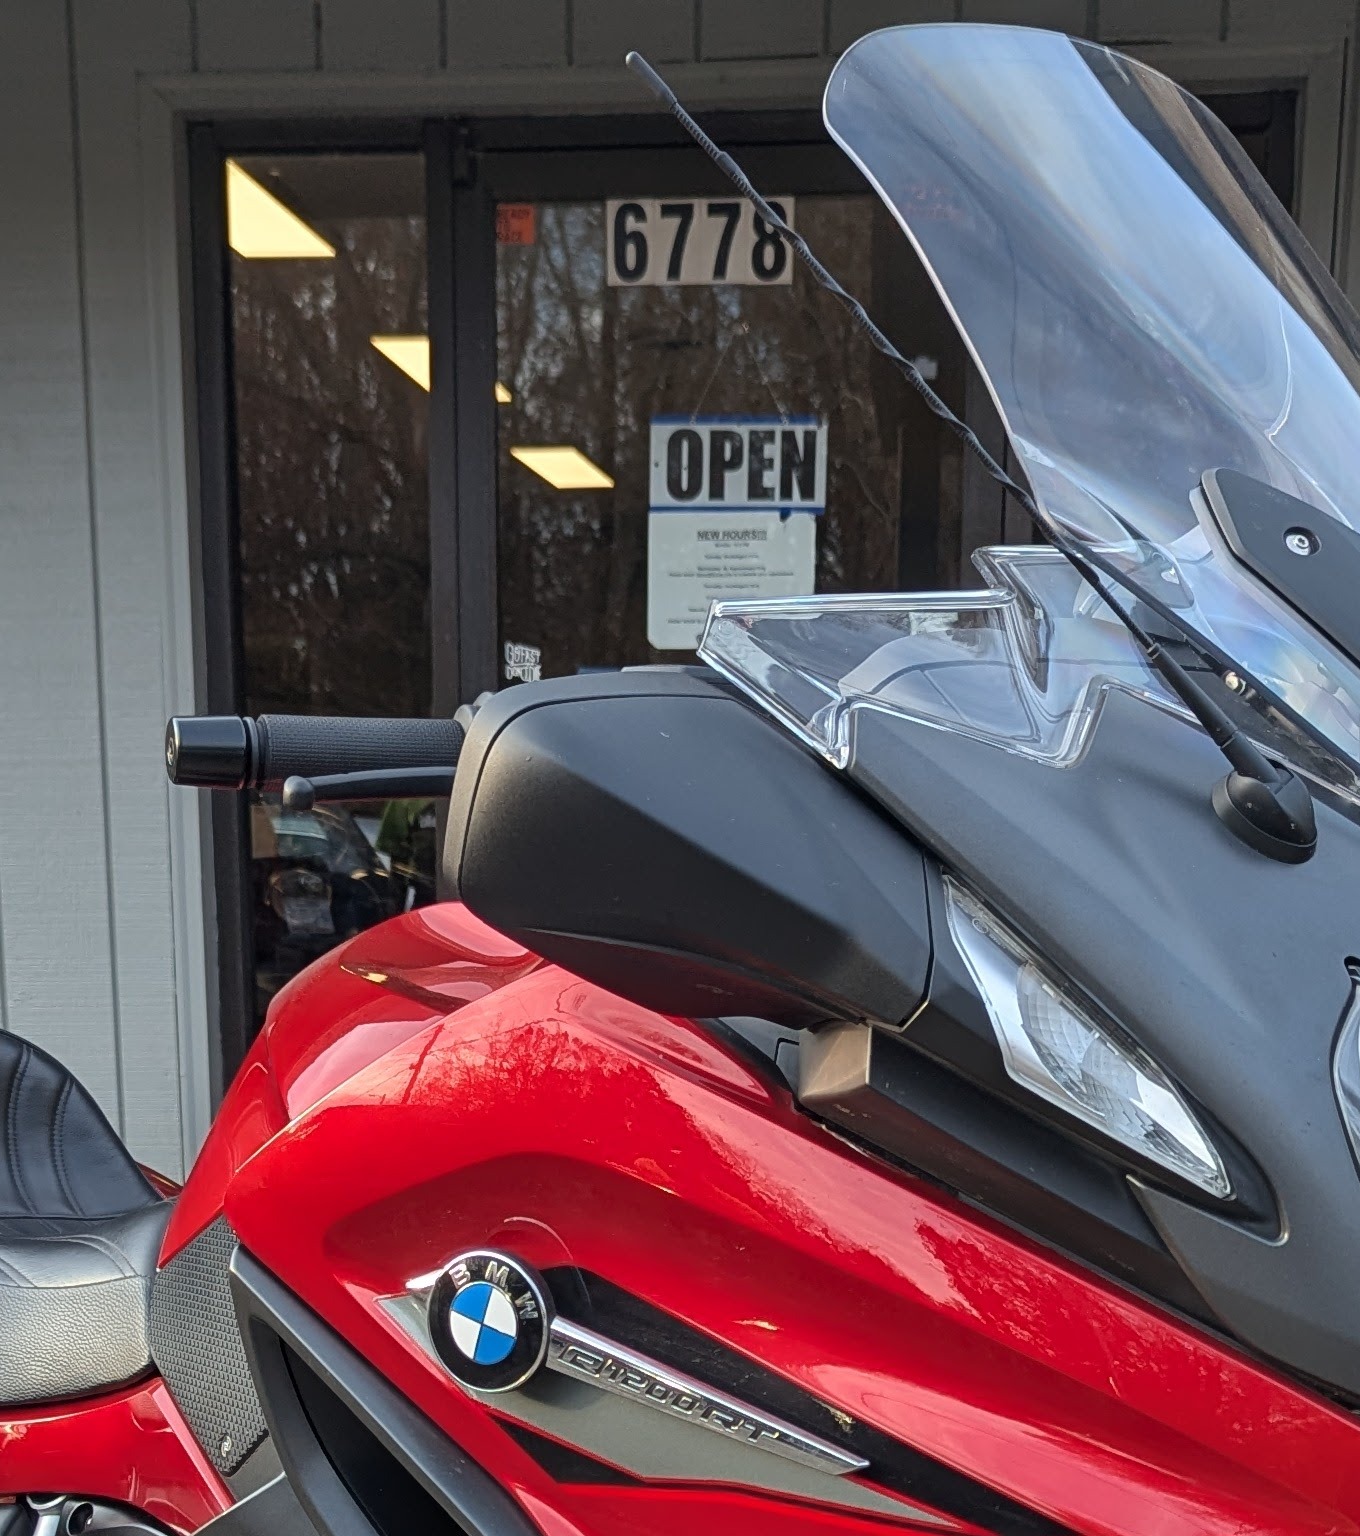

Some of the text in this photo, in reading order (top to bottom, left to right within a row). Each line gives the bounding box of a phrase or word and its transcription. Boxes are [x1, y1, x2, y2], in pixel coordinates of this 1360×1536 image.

[612, 202, 788, 283] 6778
[666, 428, 819, 502] OPEN
[697, 531, 720, 541] NEW
[448, 1260, 539, 1319] BMW
